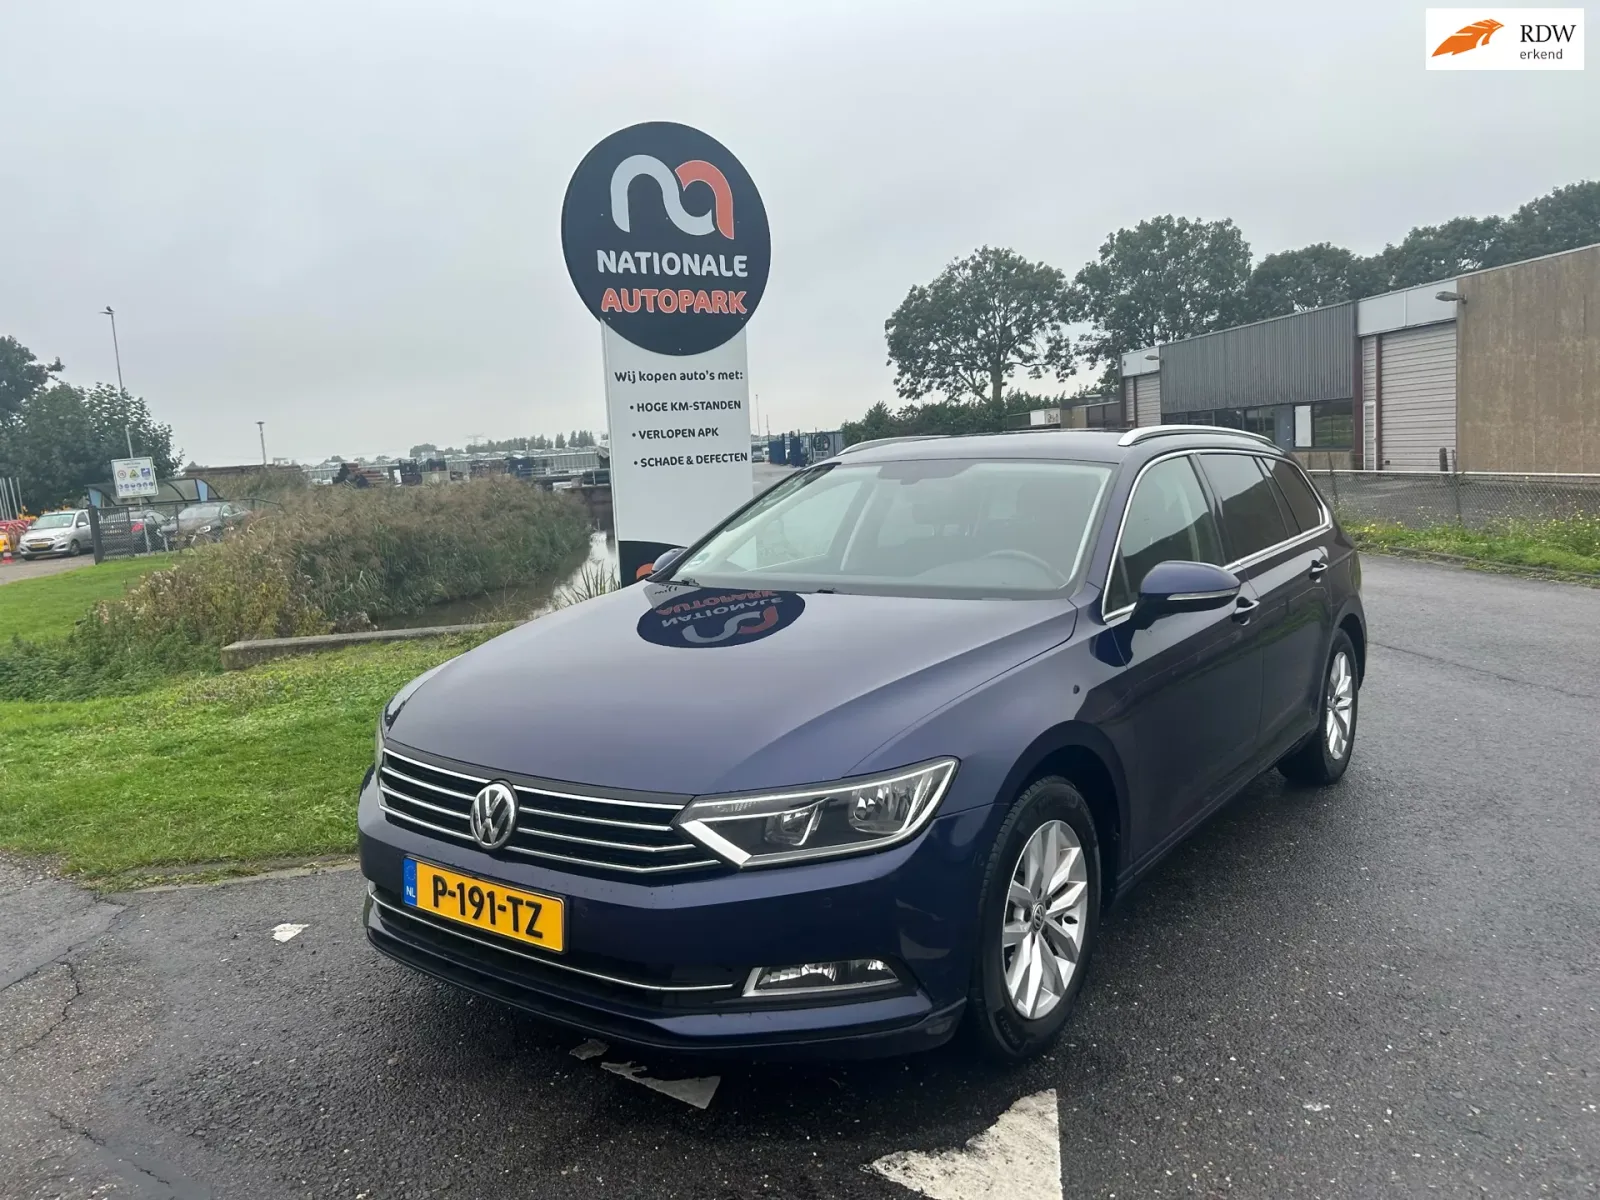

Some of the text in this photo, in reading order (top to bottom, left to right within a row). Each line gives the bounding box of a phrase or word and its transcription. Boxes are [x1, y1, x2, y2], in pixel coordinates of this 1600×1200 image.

[596, 249, 748, 278] NATIONALE
[600, 287, 748, 315] AUTOPARK
[614, 370, 744, 384] Wij kopen auto's met:
[636, 400, 742, 412] HOGE KM-STANDEN
[638, 427, 719, 440] VERLOPEN APK
[640, 452, 748, 468] SCHADE & DEFECTEN
[405, 885, 416, 899] NL
[432, 874, 543, 939] P-191-TZ
